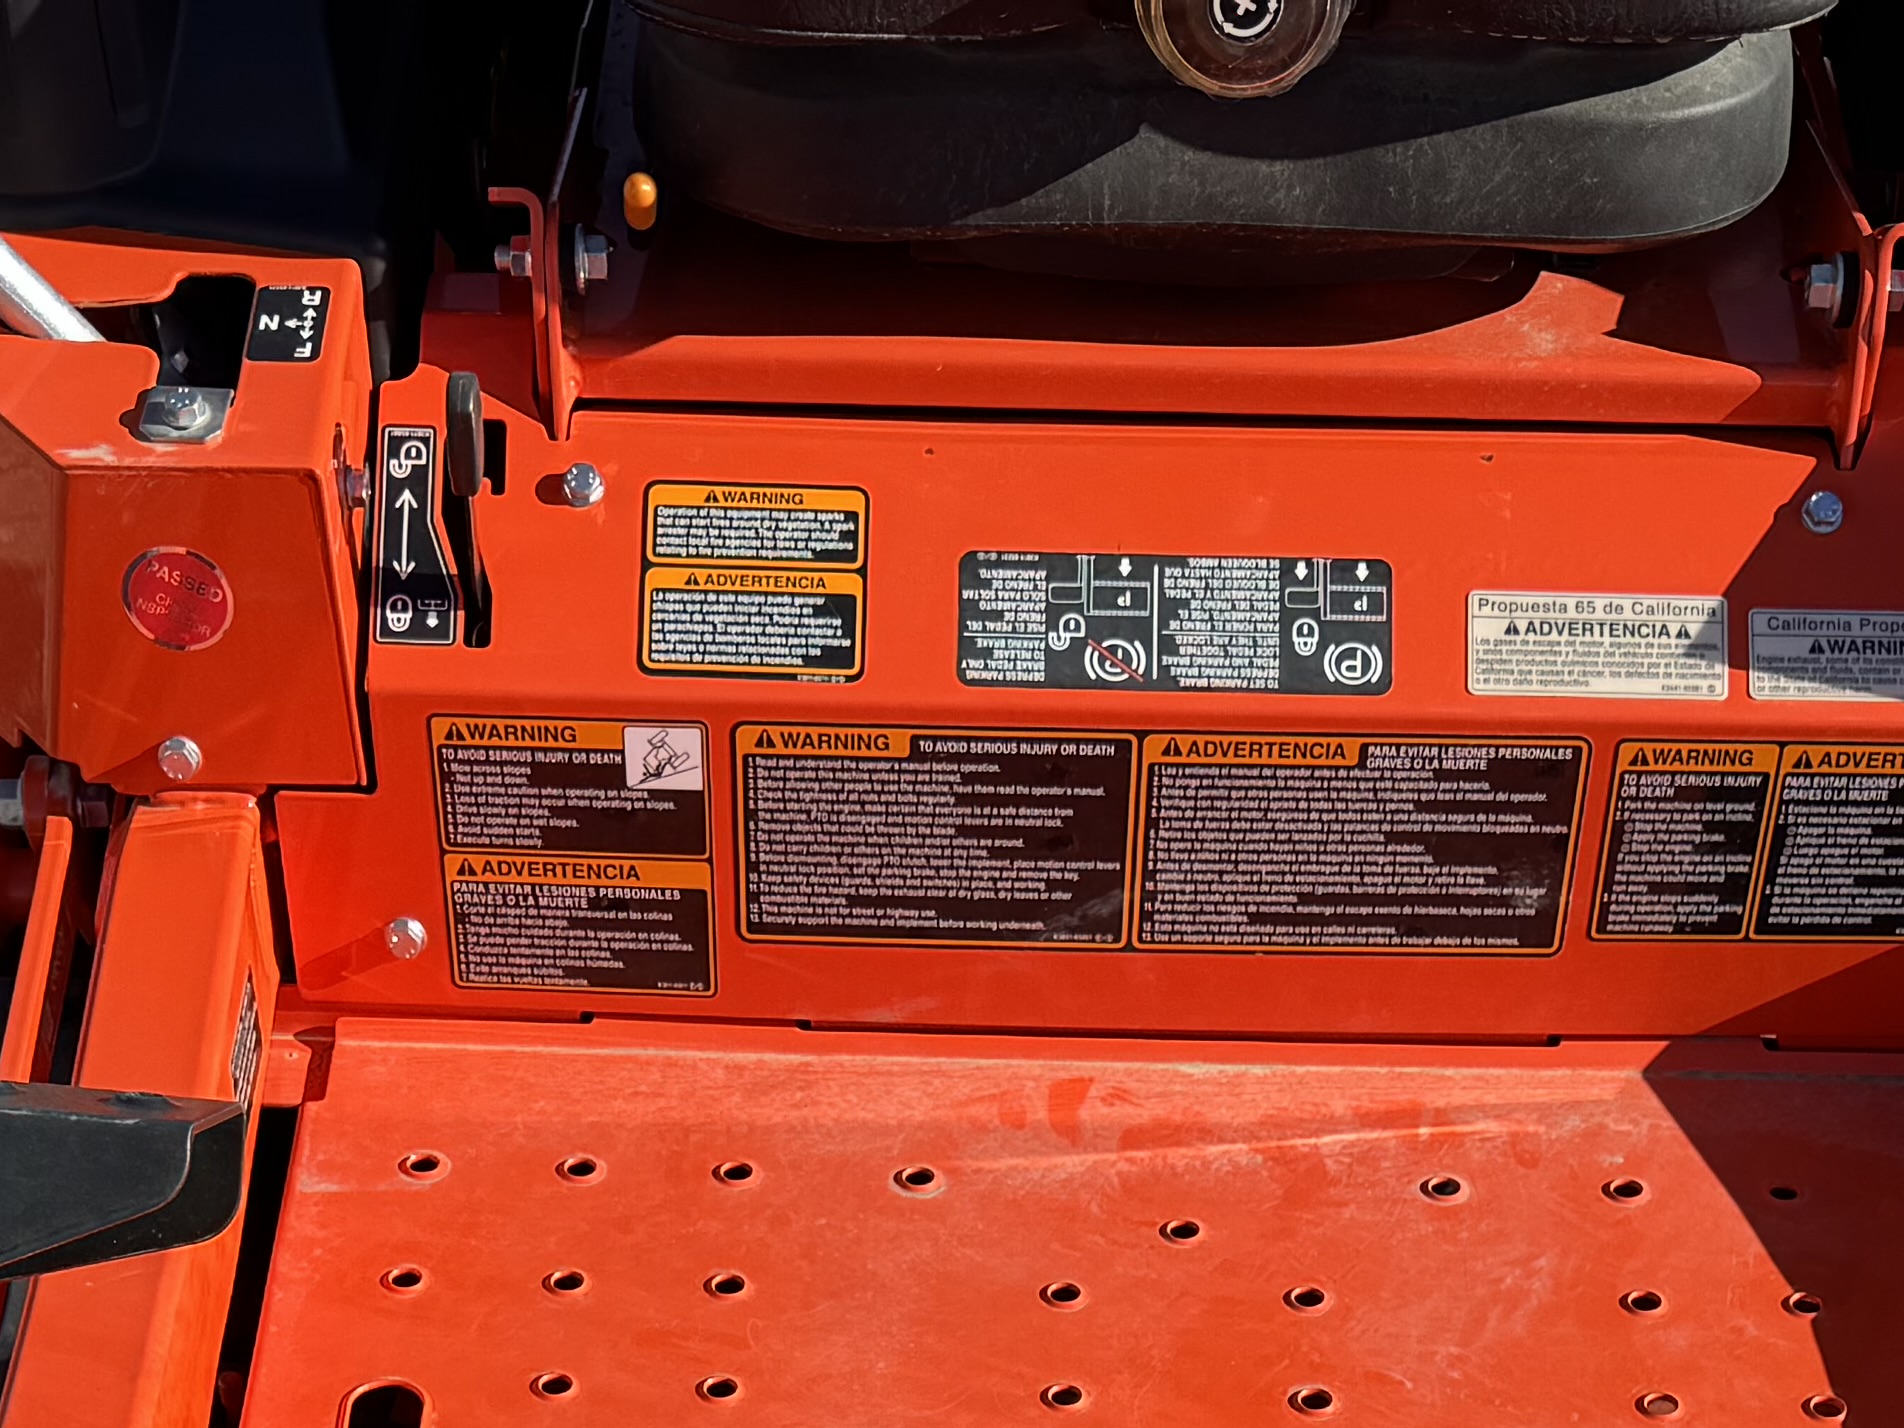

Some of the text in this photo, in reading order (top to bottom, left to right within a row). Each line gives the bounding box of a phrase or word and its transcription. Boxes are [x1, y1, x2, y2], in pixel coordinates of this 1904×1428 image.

[302, 290, 321, 306] R
[259, 314, 280, 330] N
[294, 342, 312, 357] F
[722, 491, 803, 505] WARNING
[146, 559, 223, 603] PASSED
[704, 573, 827, 589] ADVERTENCIA
[1478, 598, 1716, 618] Propuesta 65 de California
[1524, 620, 1671, 639] ADVERTENCIA
[1767, 616, 1851, 632] California
[466, 723, 576, 743] WARNING
[782, 730, 890, 752] WARNING
[442, 748, 622, 765] TO AVOID SERIOUS INJURY OR DEATH
[919, 741, 1115, 757] TO AVOID SERIOUS INJURY OR DEATH
[1185, 740, 1347, 760] ADVERTENCIA
[1368, 745, 1573, 760] PARA EVITAR LESIONES PERSONALES
[1366, 757, 1488, 771] GRAVES O LA MUERTE
[1652, 748, 1754, 767] WARNING
[1623, 774, 1763, 787] TO AVOID SERIOUS INJURY
[1785, 776, 1811, 787] PARA
[1813, 776, 1847, 788] EVITAR
[1848, 777, 1897, 789] LESIONES
[1621, 786, 1675, 798] OR DEATH
[1782, 789, 1889, 801] GRAVES O LA MUERTE
[481, 861, 640, 881] ADVERTENCIA
[453, 882, 681, 900] PARA EVITAR LESIONES PERSONALES
[456, 893, 588, 908] GRAVES O LA MUERTE
